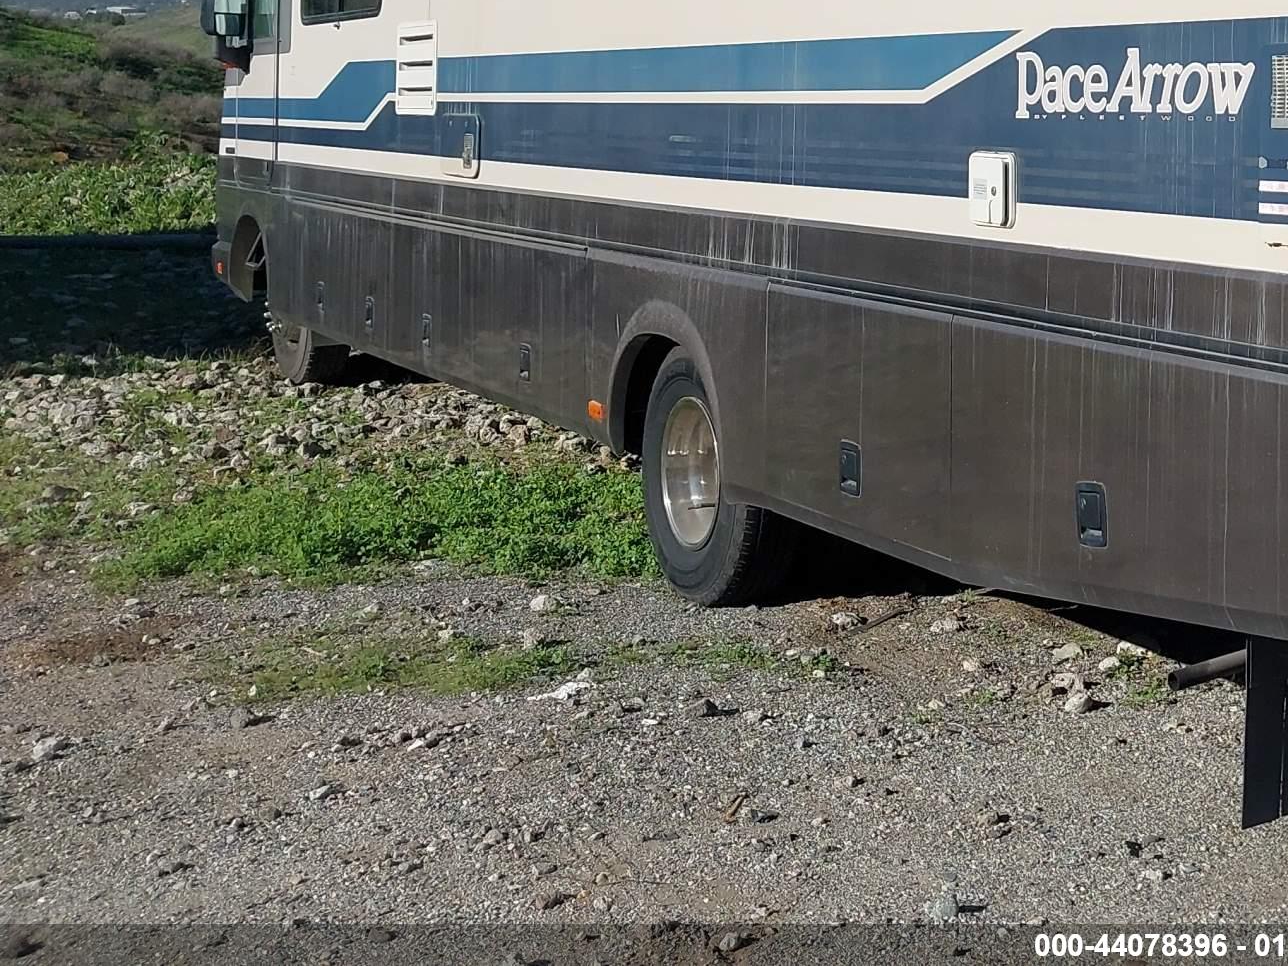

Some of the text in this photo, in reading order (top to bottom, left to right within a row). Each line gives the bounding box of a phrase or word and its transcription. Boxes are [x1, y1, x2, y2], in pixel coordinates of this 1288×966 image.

[1015, 47, 1256, 119] Pace Arrow
[1060, 114, 1236, 122] FLEETWOOD
